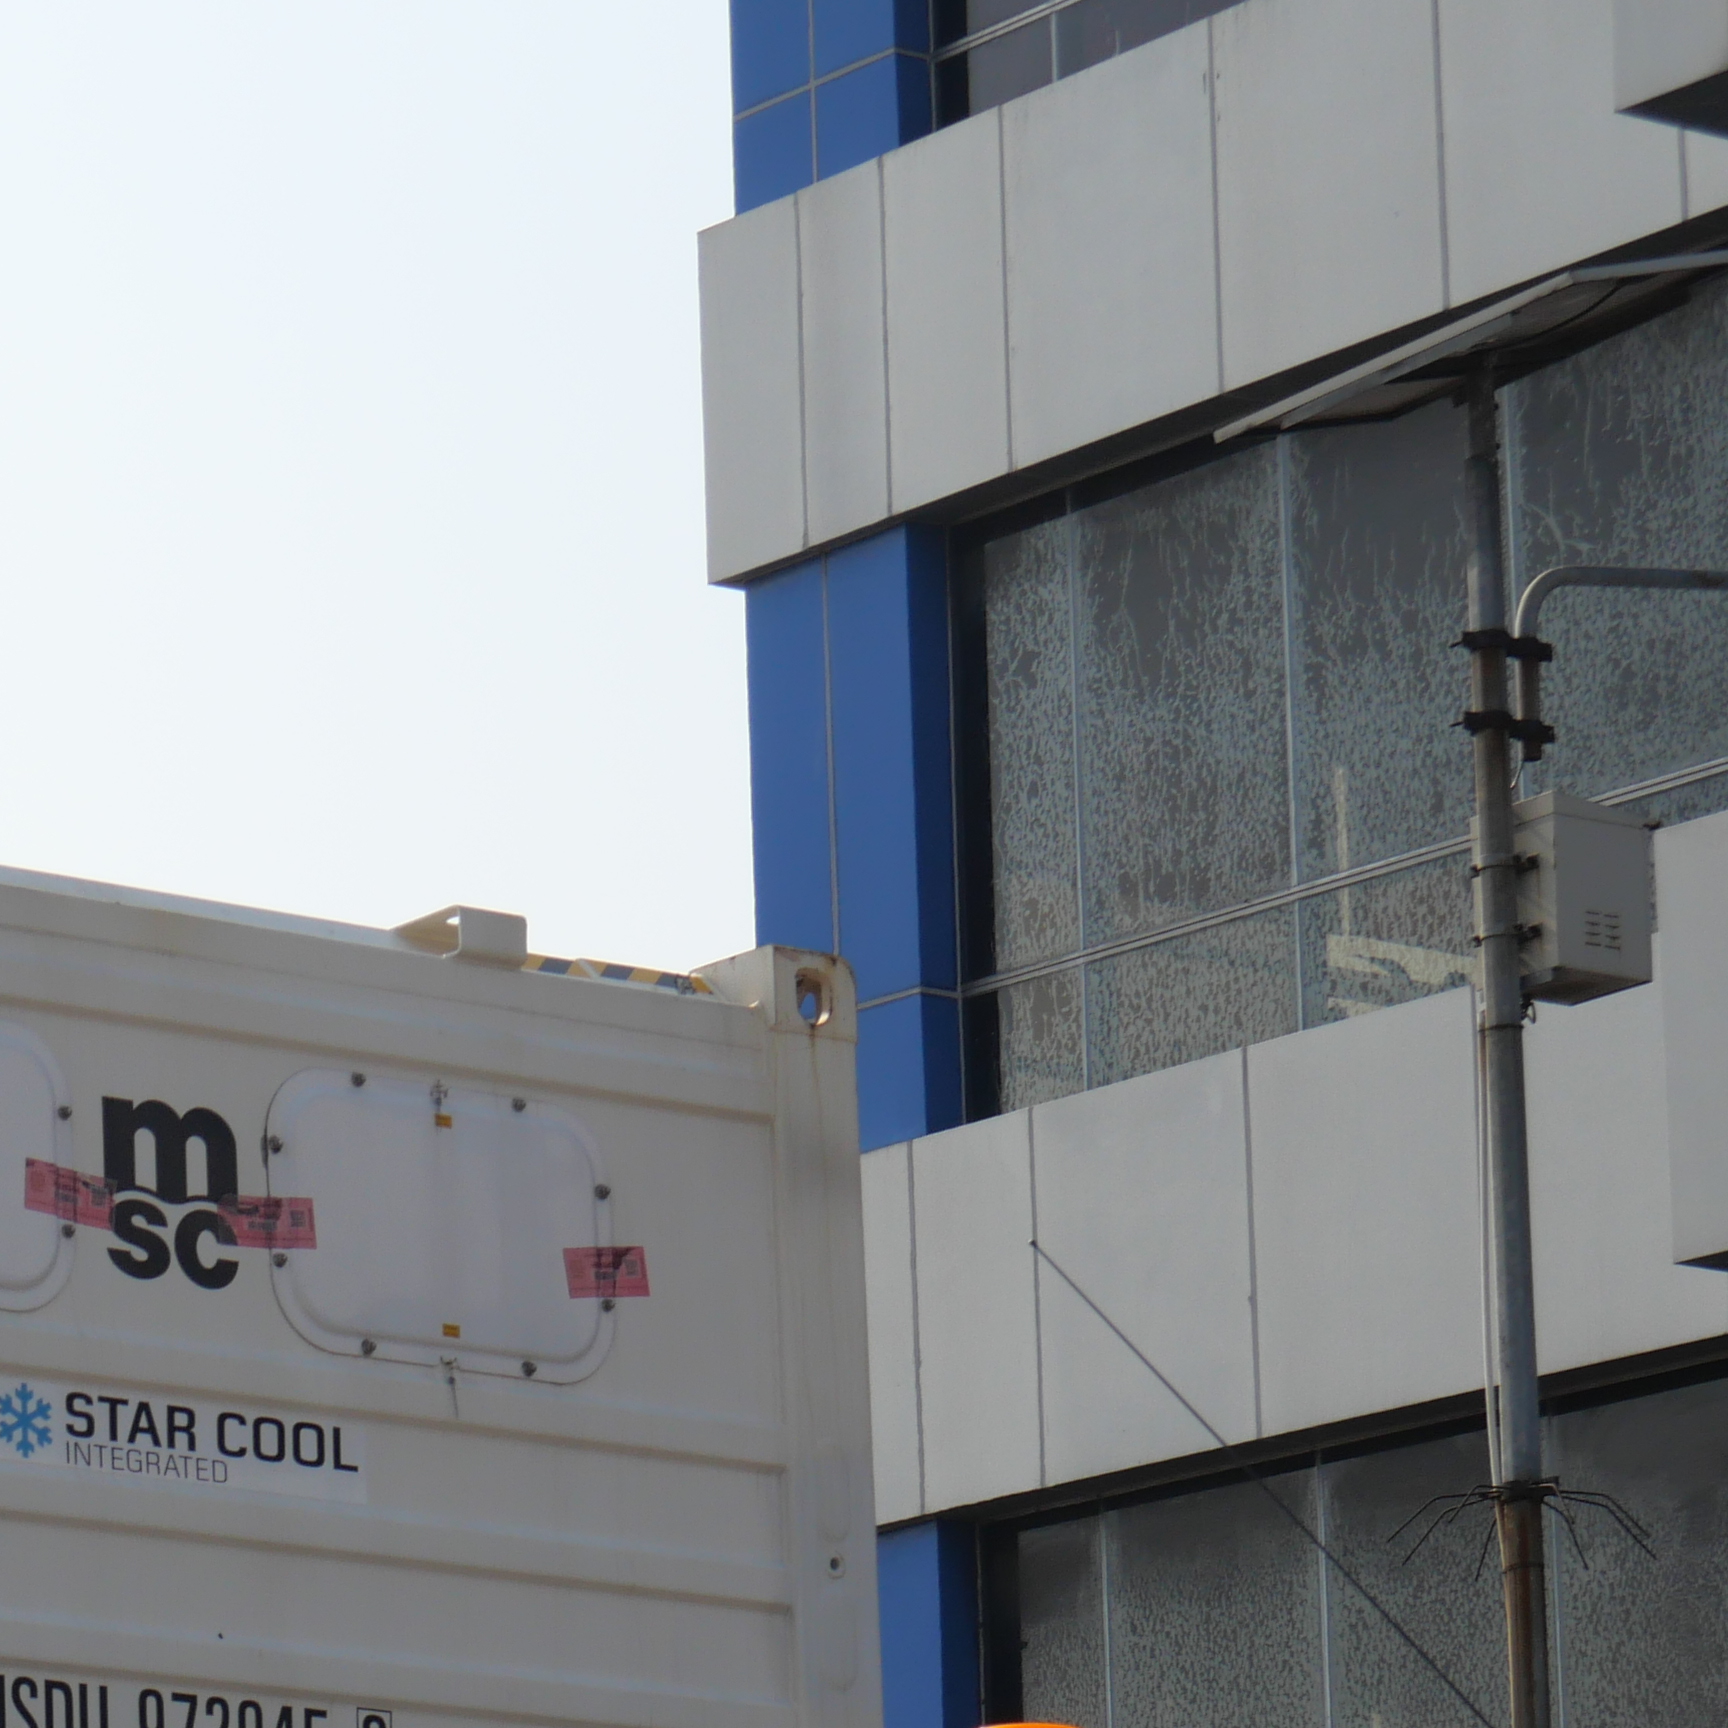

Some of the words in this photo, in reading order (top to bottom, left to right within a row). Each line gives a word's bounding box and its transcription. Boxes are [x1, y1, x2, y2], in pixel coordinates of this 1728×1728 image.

[65, 1391, 196, 1452] STAR
[216, 1412, 358, 1473] COOL
[65, 1440, 227, 1484] INTEGRATED
